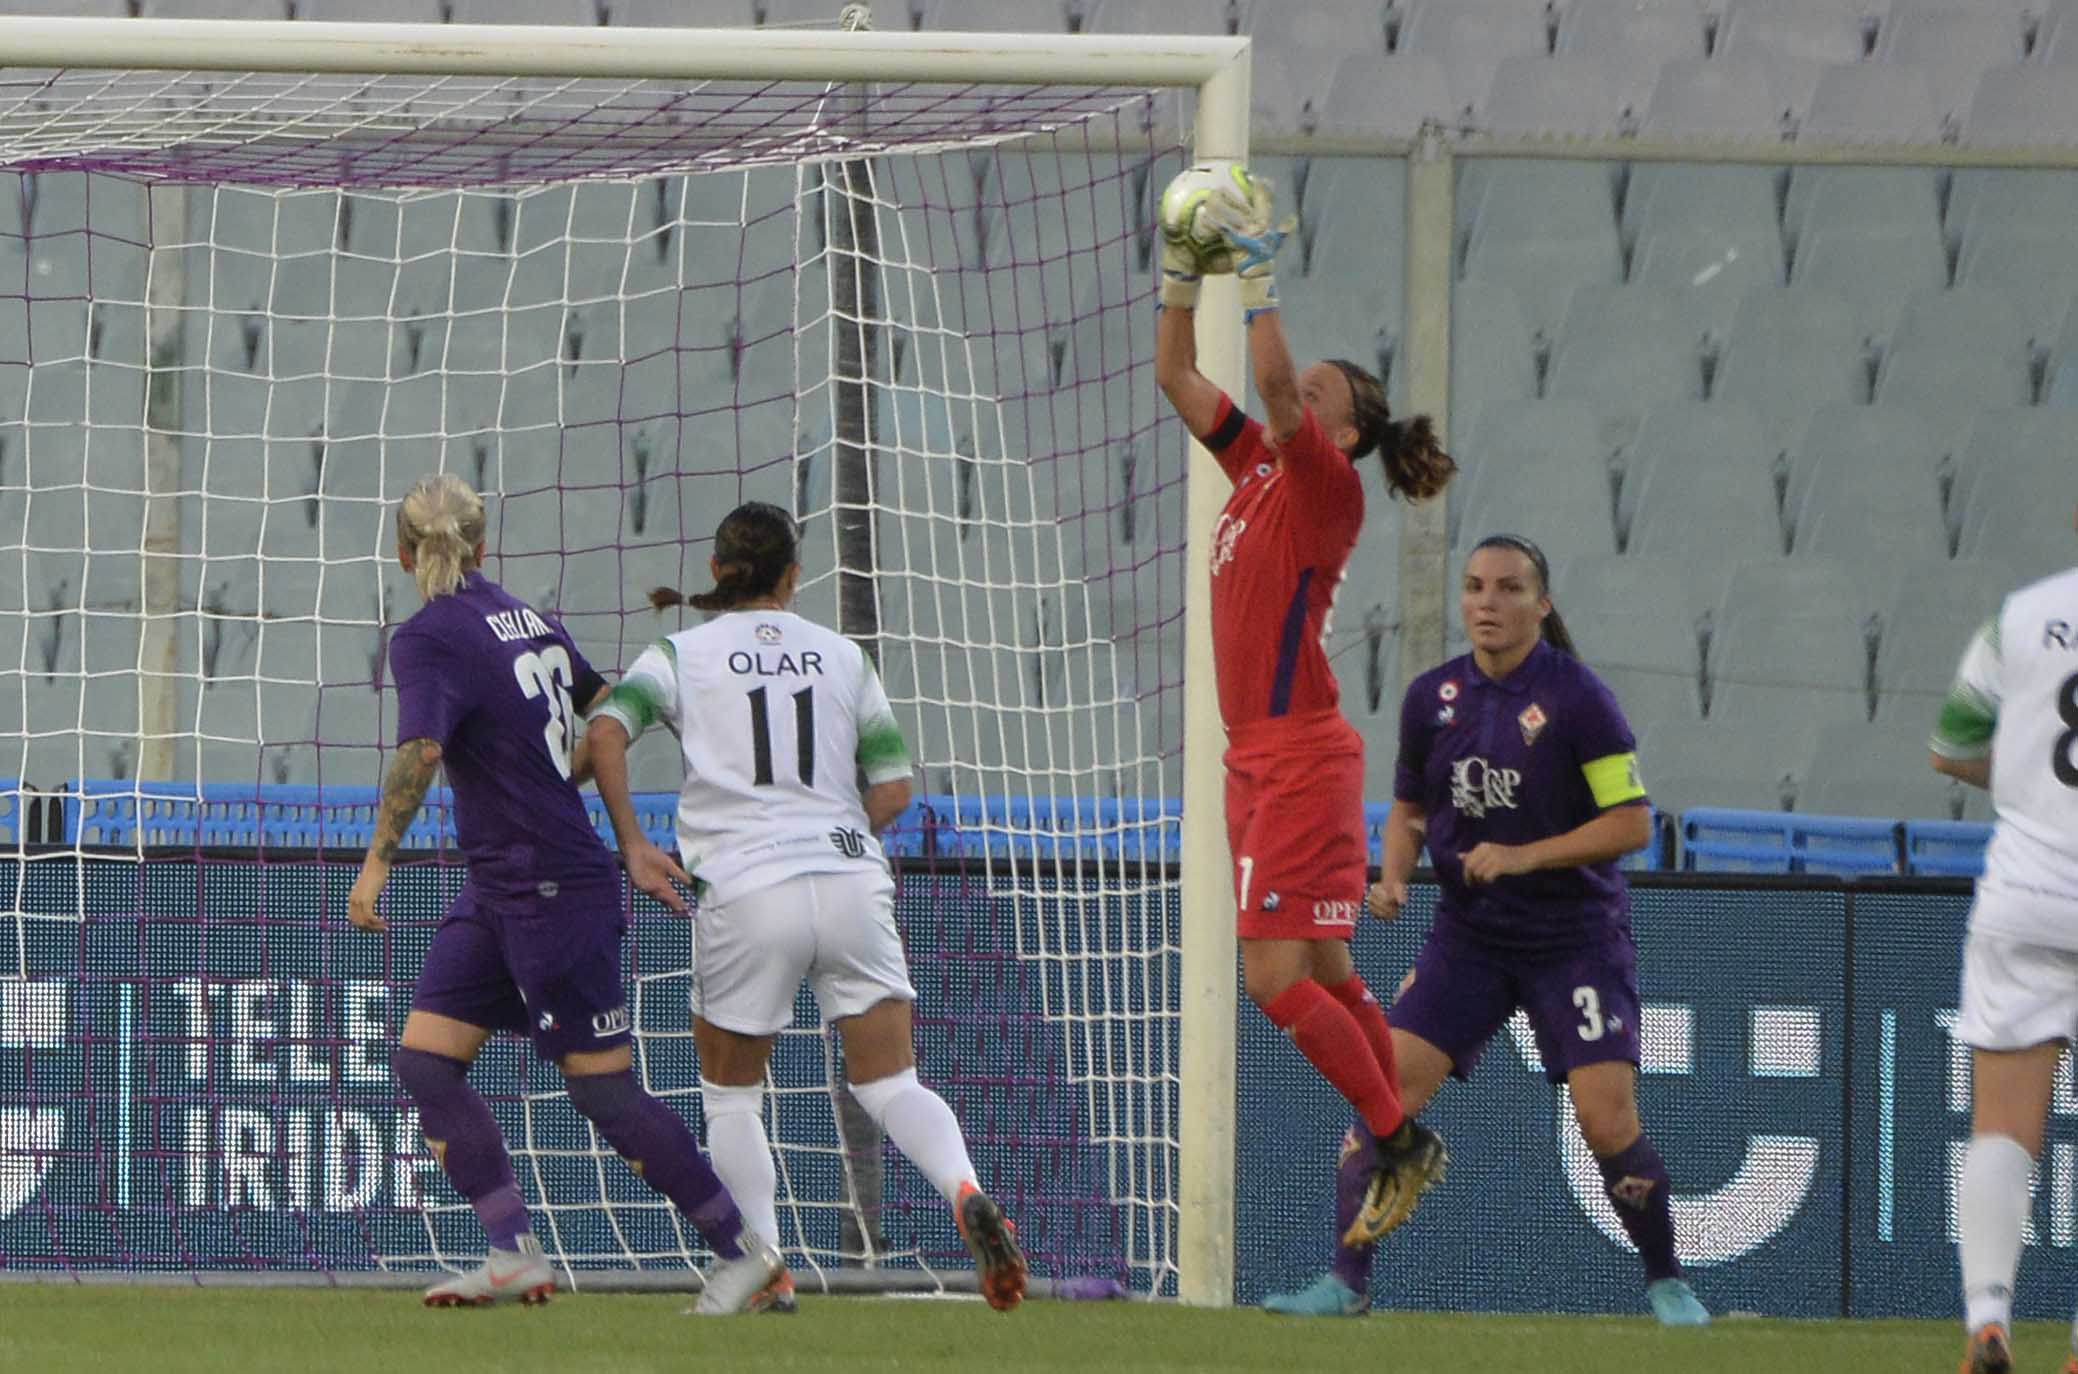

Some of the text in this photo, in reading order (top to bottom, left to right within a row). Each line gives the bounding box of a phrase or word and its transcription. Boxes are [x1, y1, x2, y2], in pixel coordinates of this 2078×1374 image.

[728, 651, 824, 676] OLAR
[746, 685, 814, 789] 11
[172, 977, 390, 1081] TELE
[1572, 985, 1604, 1042] 3
[184, 1107, 439, 1212] IRIDE
